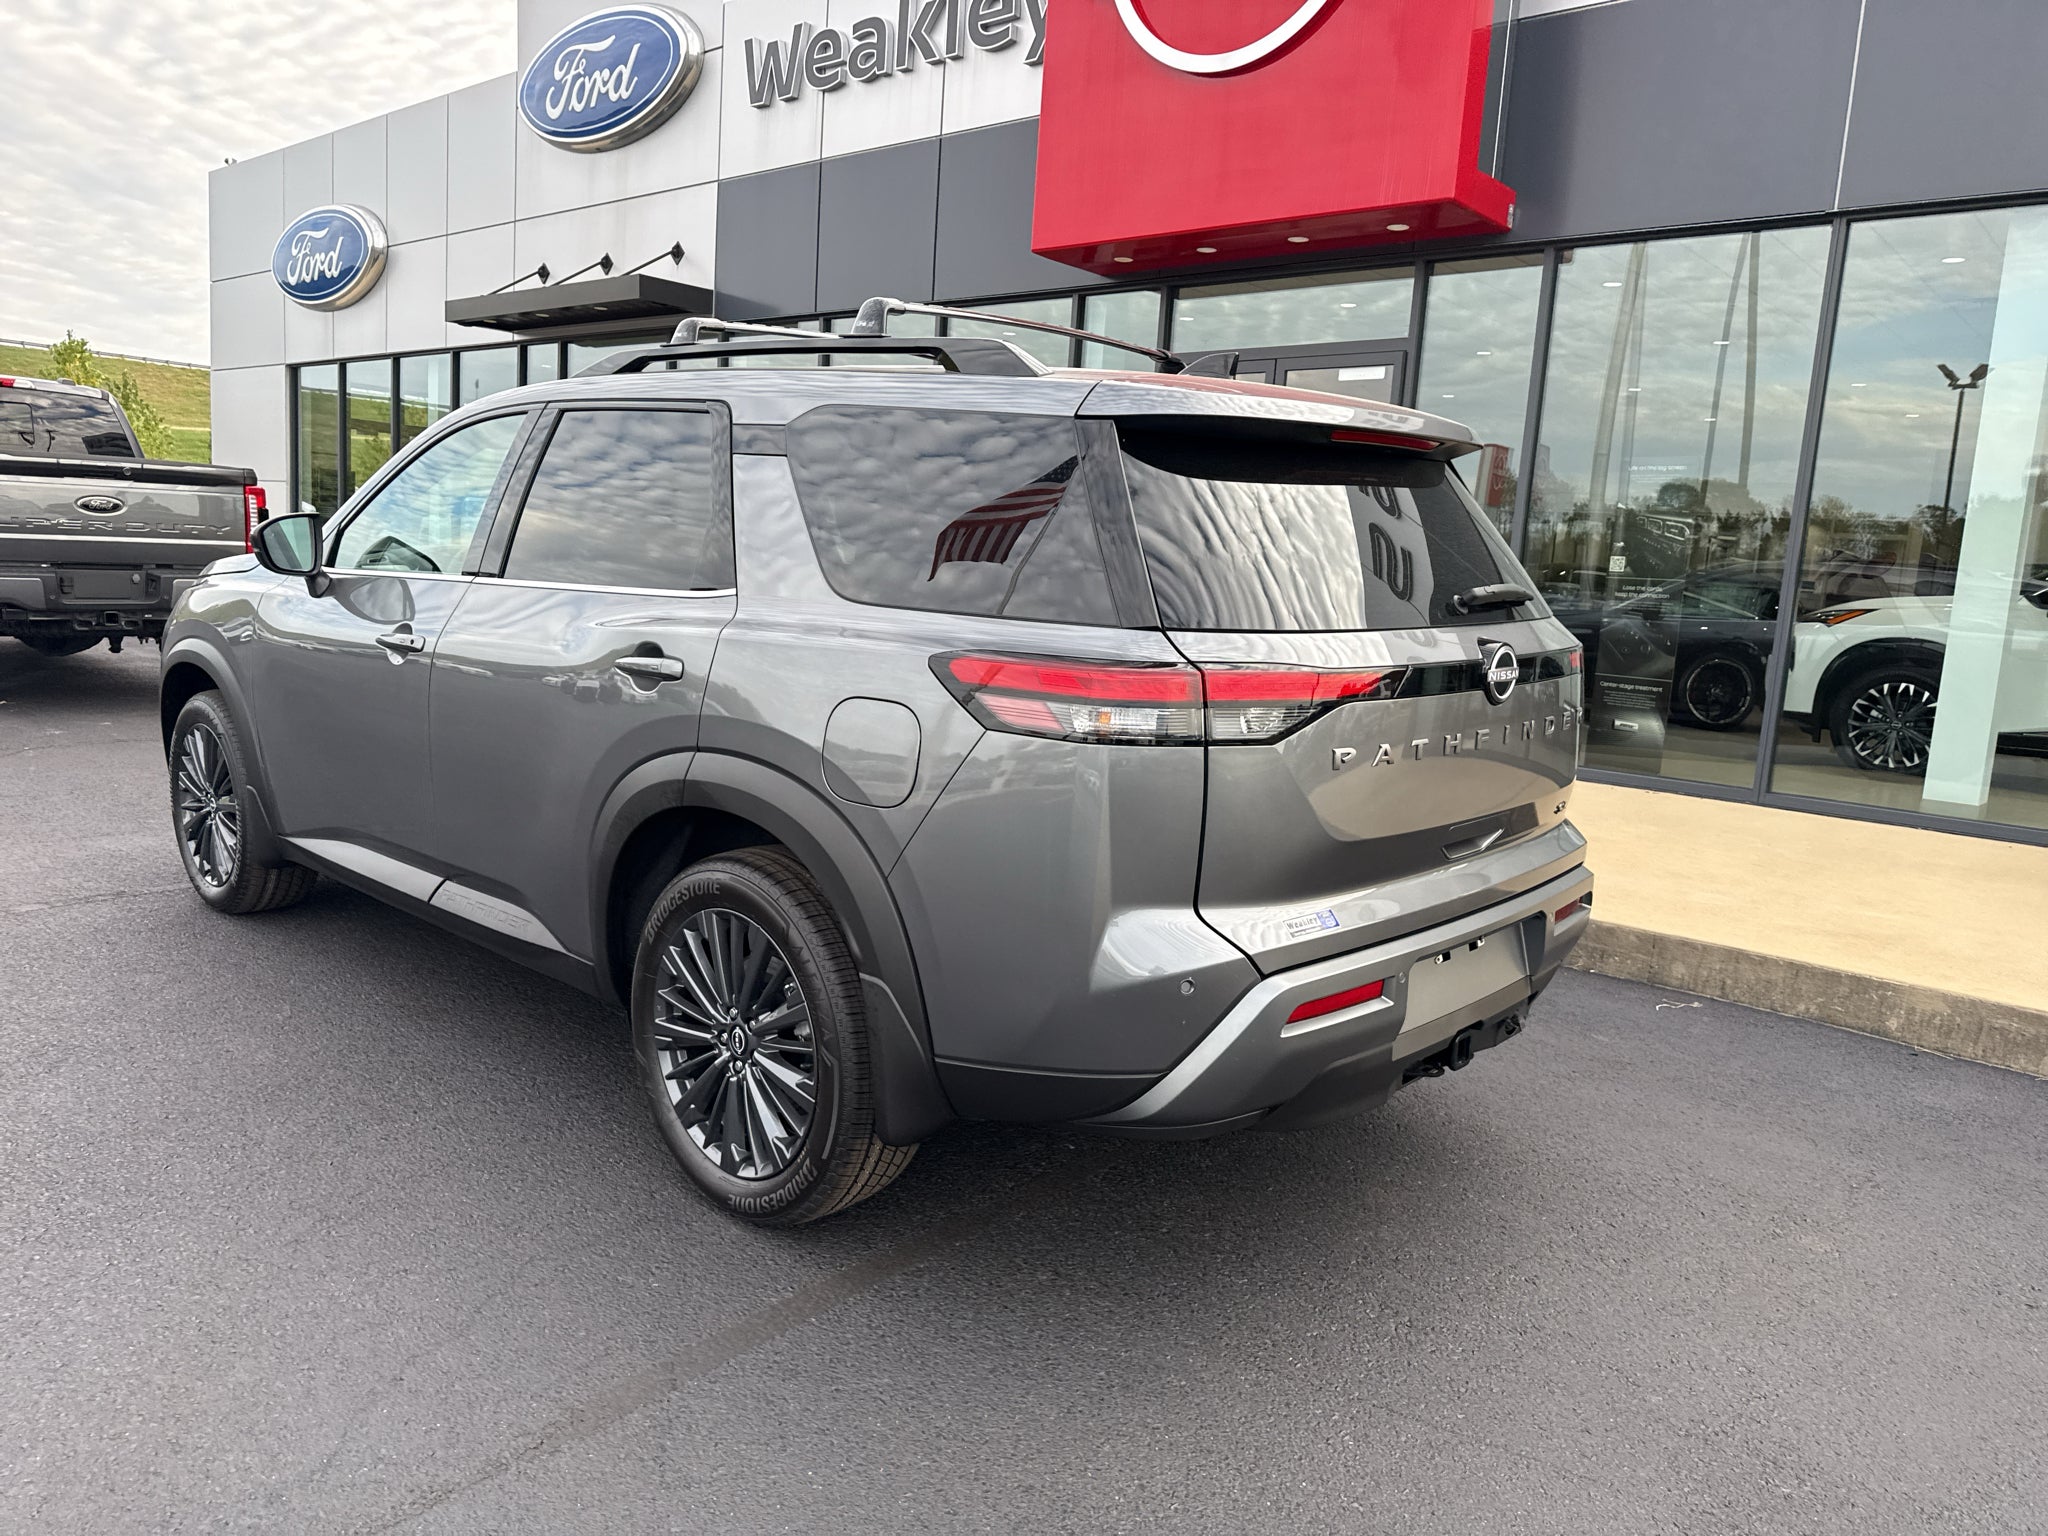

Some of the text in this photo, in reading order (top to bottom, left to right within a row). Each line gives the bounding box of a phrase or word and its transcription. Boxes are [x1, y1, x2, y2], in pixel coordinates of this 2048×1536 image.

[545, 35, 641, 120] Ford
[286, 227, 345, 286] Ford
[126, 521, 231, 535] DUTY
[1488, 669, 1519, 681] NISSAN
[644, 880, 721, 945] BRIDGESTONE
[727, 1157, 818, 1214] BRIDGESTONE
